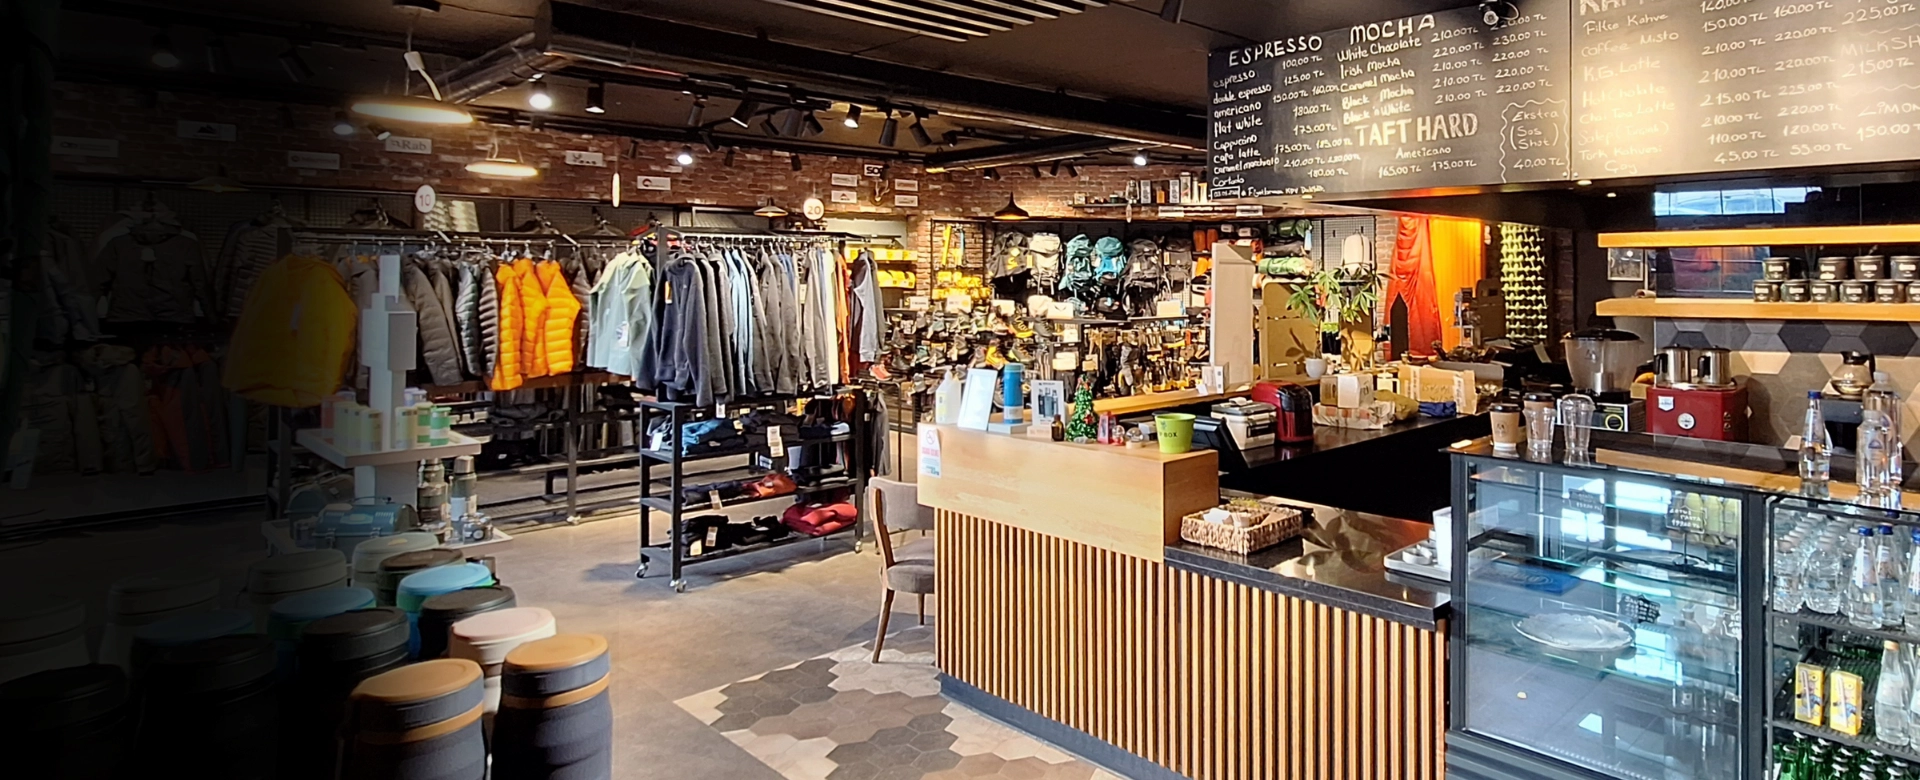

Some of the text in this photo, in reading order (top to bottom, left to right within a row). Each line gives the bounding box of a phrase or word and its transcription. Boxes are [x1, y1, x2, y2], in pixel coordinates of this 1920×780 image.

[1900, 3, 1916, 13] TL
[1627, 14, 1668, 26] Kahve
[1640, 30, 1679, 45] Misto
[1749, 12, 1768, 22] TL
[1816, 1, 1834, 10] TL
[1350, 14, 1435, 45] MOCHA
[1749, 37, 1766, 46] TL
[1819, 26, 1837, 34] TL
[1229, 36, 1322, 67] ESPRESSO
[1337, 46, 1369, 62] White
[1370, 35, 1422, 55] Chocolate
[1340, 64, 1363, 80] Irish
[1367, 57, 1401, 72] Mocha
[1472, 42, 1485, 50] TL
[1896, 57, 1915, 67] TL
[1213, 70, 1255, 89] espresso
[1340, 76, 1377, 92] Caramel
[1380, 69, 1415, 83] Mocha
[1341, 95, 1370, 111] Black
[1380, 84, 1415, 103] Mocha
[1471, 73, 1486, 81] TL
[1537, 64, 1550, 72] TL
[1583, 90, 1605, 108] Hot
[1747, 66, 1766, 75] TL
[1343, 110, 1370, 126] Black
[1380, 102, 1412, 117] White
[1539, 79, 1553, 87] TL
[1637, 100, 1676, 115] Latte
[1753, 89, 1771, 99] TL
[1826, 81, 1840, 89] TL
[1214, 101, 1261, 118] americano
[1512, 109, 1560, 122] Ekstra
[1745, 112, 1763, 120] TL
[1828, 103, 1842, 111] TL
[1214, 121, 1232, 138] flat
[1236, 114, 1263, 130] white
[1320, 103, 1332, 112] TL
[1326, 122, 1337, 131] TL
[1354, 112, 1478, 147] TAFT HARD
[1749, 131, 1767, 139] TL
[1831, 122, 1846, 130] TL
[402, 140, 427, 151] Rab
[1238, 148, 1260, 158] latte
[1396, 147, 1452, 160] Americano
[1762, 149, 1780, 158] TL
[1835, 143, 1852, 151] TL
[1315, 156, 1326, 164] TL
[1410, 165, 1422, 173] TL
[1464, 159, 1477, 168] TL
[1549, 157, 1565, 166] TL
[1212, 175, 1245, 187] Cortado
[1337, 167, 1348, 176] TL
[419, 194, 431, 207] 10
[807, 205, 822, 215] 20
